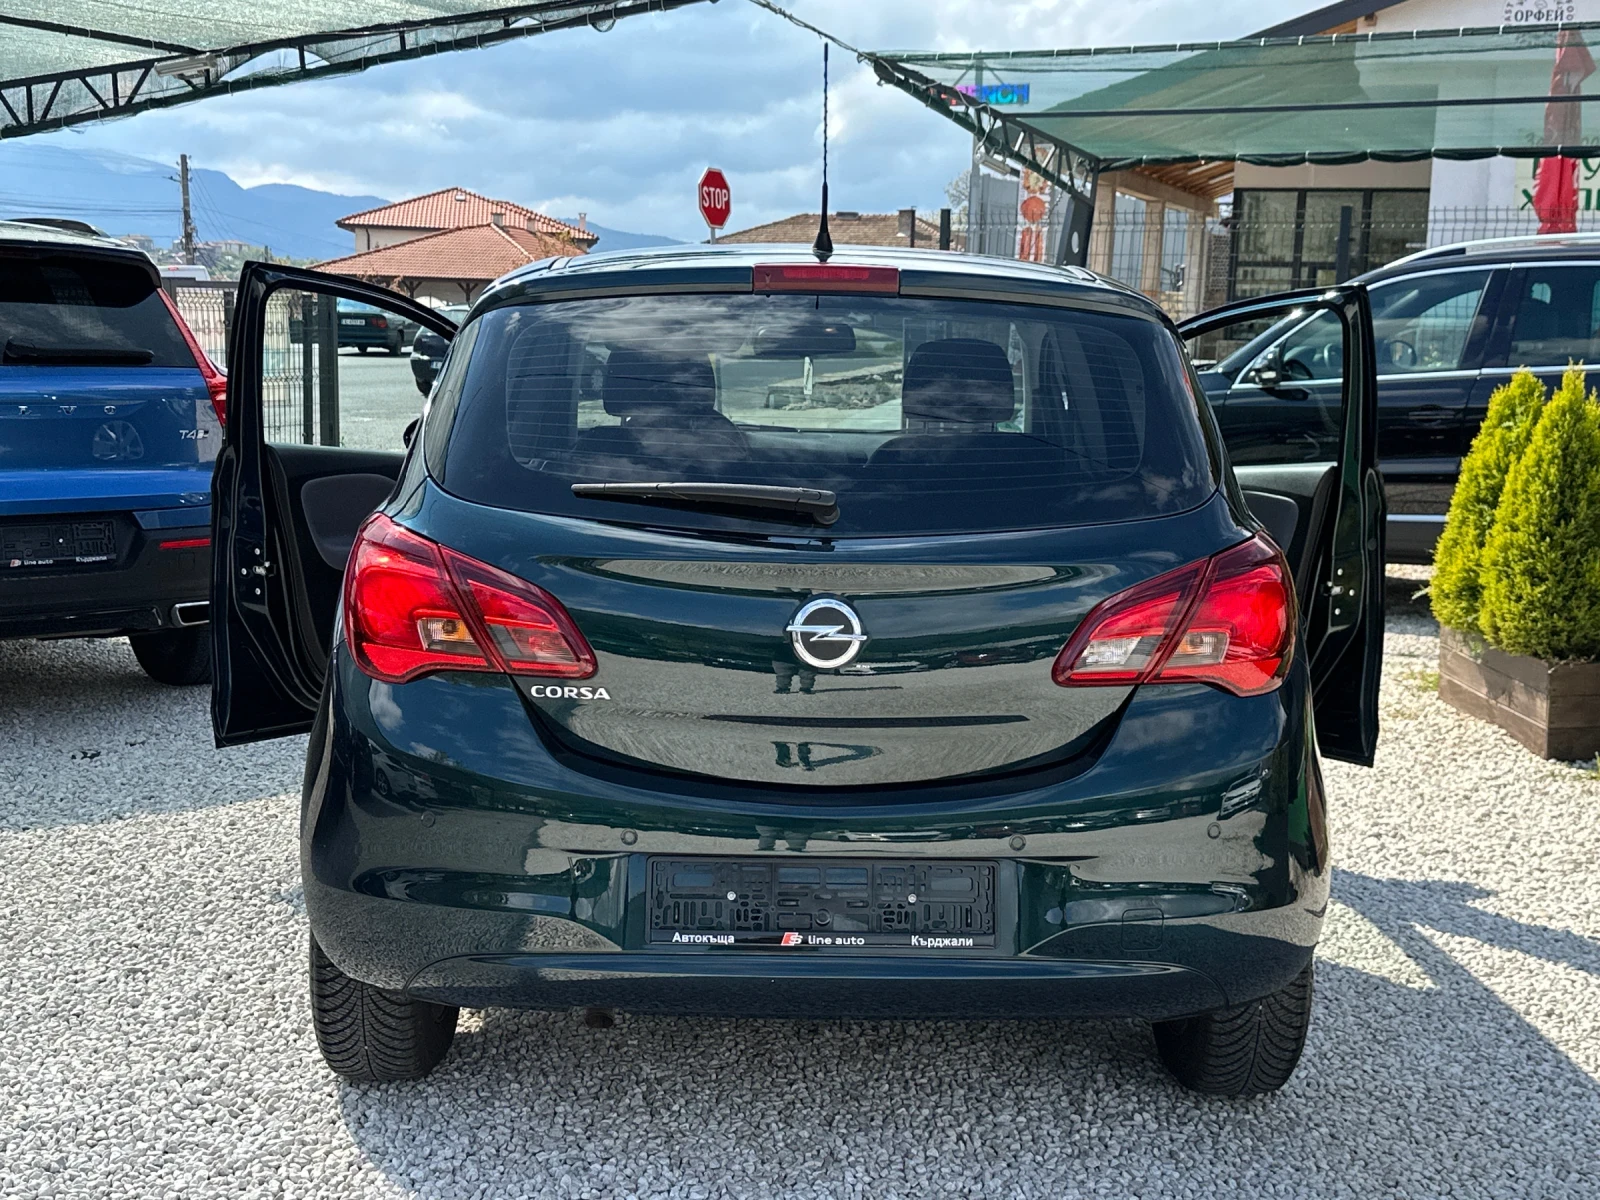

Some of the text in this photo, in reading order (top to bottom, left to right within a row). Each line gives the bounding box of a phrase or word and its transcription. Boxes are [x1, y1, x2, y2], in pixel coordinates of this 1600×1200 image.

[1514, 6, 1564, 22] ОРФЕЙ
[702, 186, 729, 210] STOP
[530, 685, 611, 700] CORSA
[672, 931, 735, 945] Автокъща
[807, 934, 832, 945] line
[836, 935, 865, 945] auto
[910, 934, 974, 948] Кърджали
